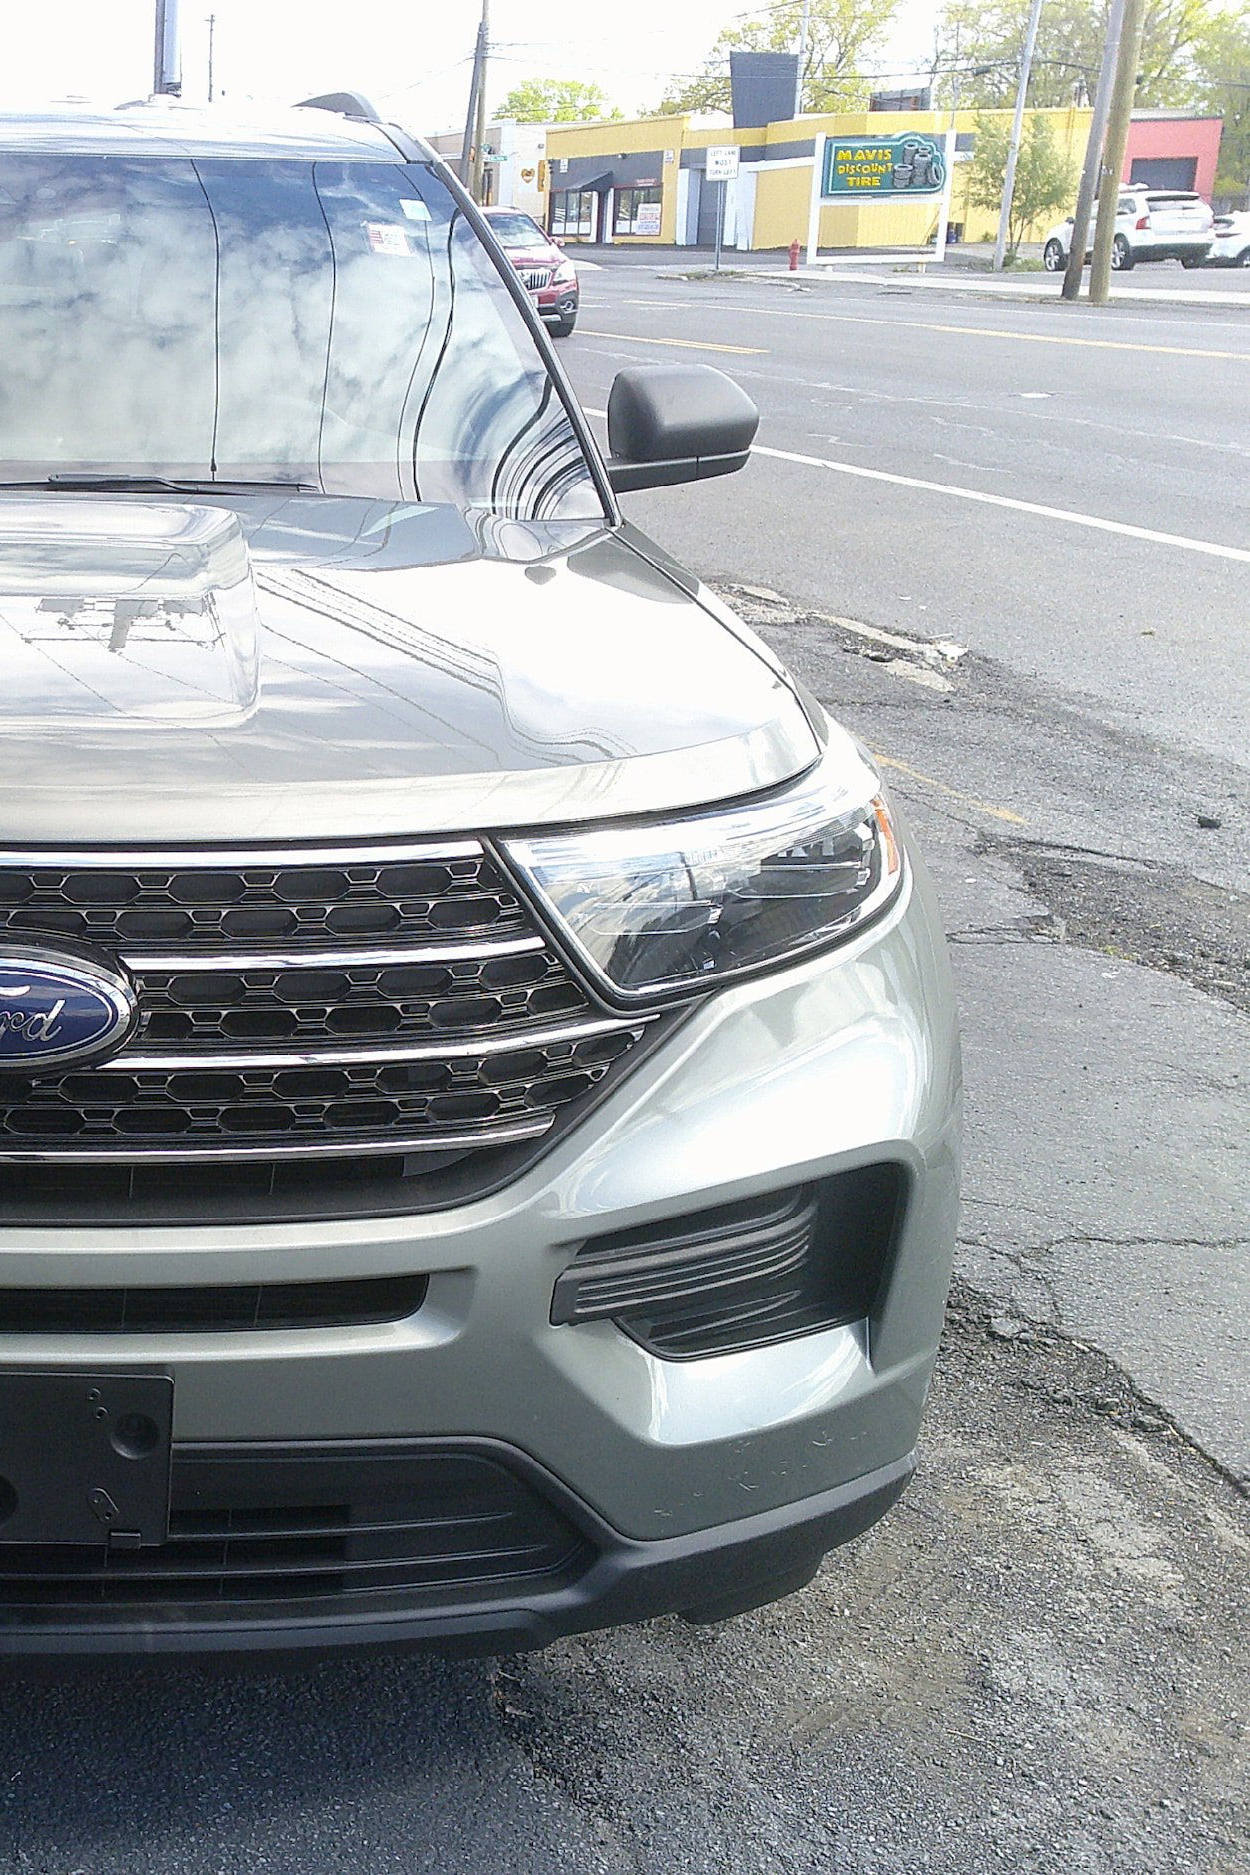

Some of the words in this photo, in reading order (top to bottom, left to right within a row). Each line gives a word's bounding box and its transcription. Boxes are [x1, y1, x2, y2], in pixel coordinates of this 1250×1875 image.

[837, 149, 892, 160] MAVIS
[837, 162, 893, 174] DISCOUNT
[846, 176, 881, 187] TIRE
